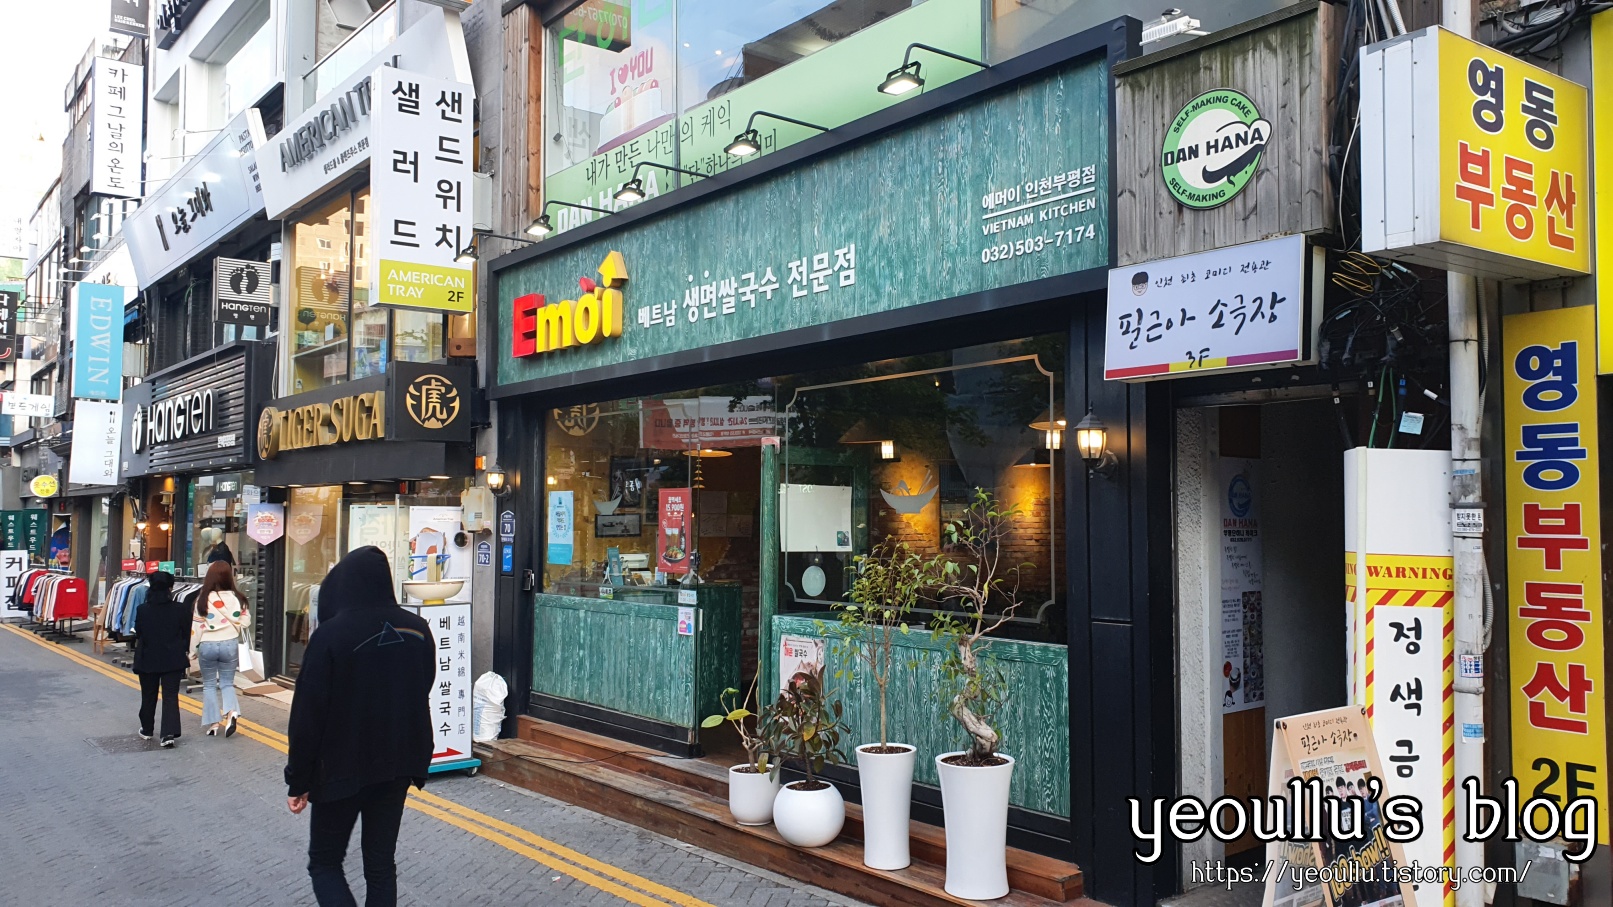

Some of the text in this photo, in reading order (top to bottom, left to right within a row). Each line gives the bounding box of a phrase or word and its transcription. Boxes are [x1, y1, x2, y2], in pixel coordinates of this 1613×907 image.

[630, 46, 654, 80] YOU
[1173, 95, 1252, 134] SELF-MAKING CAKE
[1467, 57, 1558, 152] 영동
[279, 91, 356, 173] AMERICAN
[586, 100, 731, 186] 내가 만든 나만의 케익
[1164, 127, 1264, 167] DAN HANA
[390, 80, 420, 248] 샐러드
[434, 90, 464, 262] 샌드위치
[982, 164, 1096, 210] 에머이 인천부평점
[1169, 176, 1226, 204] SELF-MAKING
[1455, 140, 1577, 253] 부동산
[558, 196, 593, 235] DAN
[982, 197, 1096, 236] VIETNAM KITCHEN
[981, 224, 1096, 263] 032)503-7174
[388, 268, 466, 289] AMERICAN
[388, 284, 424, 299] TRAY
[447, 290, 465, 303] 2F
[638, 244, 856, 329] 베트남 생면쌀국수 전문점
[87, 296, 112, 385] EDWIN
[1118, 292, 1286, 350] 필근아 소극장
[1187, 348, 1210, 370] 3F
[278, 390, 385, 451] TIGER SUGA
[1366, 564, 1454, 582] WARNING
[1532, 758, 1597, 803] 2F
